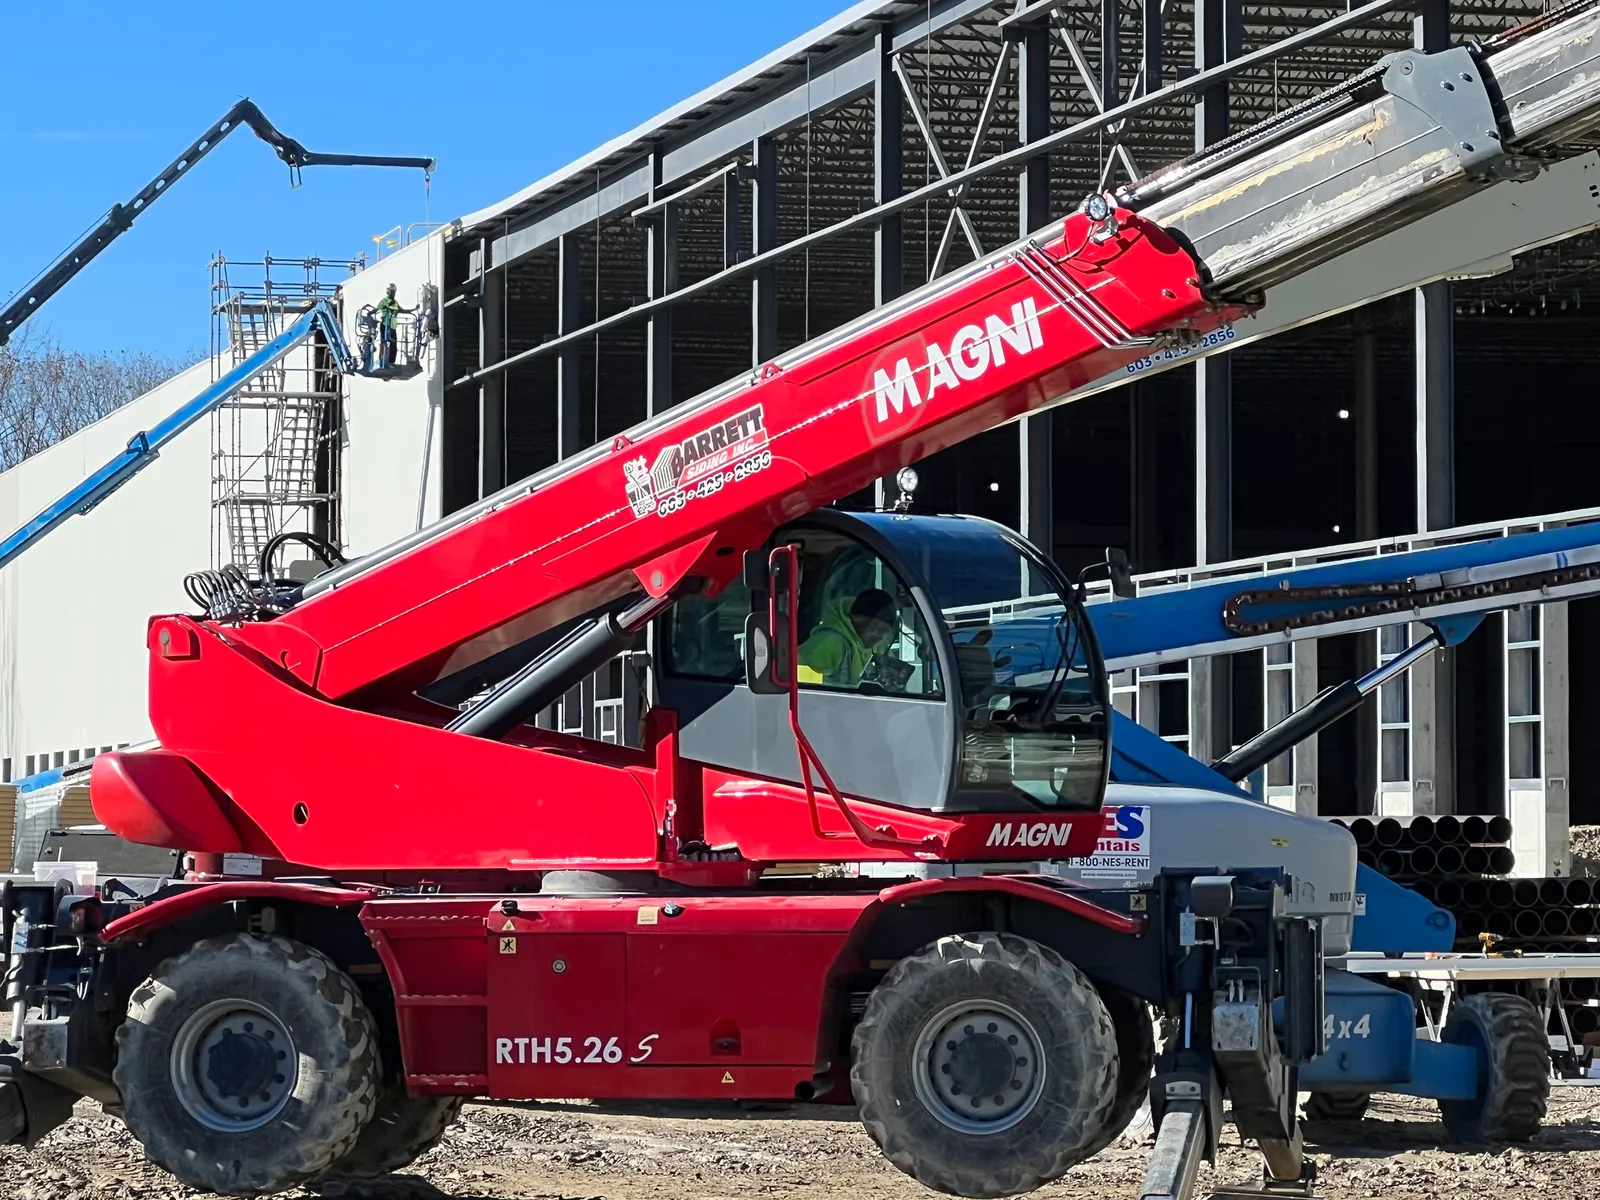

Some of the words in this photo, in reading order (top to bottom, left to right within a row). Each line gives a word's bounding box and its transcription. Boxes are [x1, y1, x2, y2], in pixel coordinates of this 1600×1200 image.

[873, 296, 1044, 424] MAGNI
[1164, 347, 1190, 361] 45
[1202, 328, 1236, 348] 2856
[670, 406, 764, 479] BARRETT
[686, 453, 728, 481] SIDING
[985, 822, 1073, 847] MAGNI
[1100, 806, 1145, 840] ES
[1096, 840, 1141, 852] ntals
[1323, 1013, 1371, 1039] 4x4
[496, 1036, 623, 1065] RTH5.26
[630, 1033, 660, 1063] S
